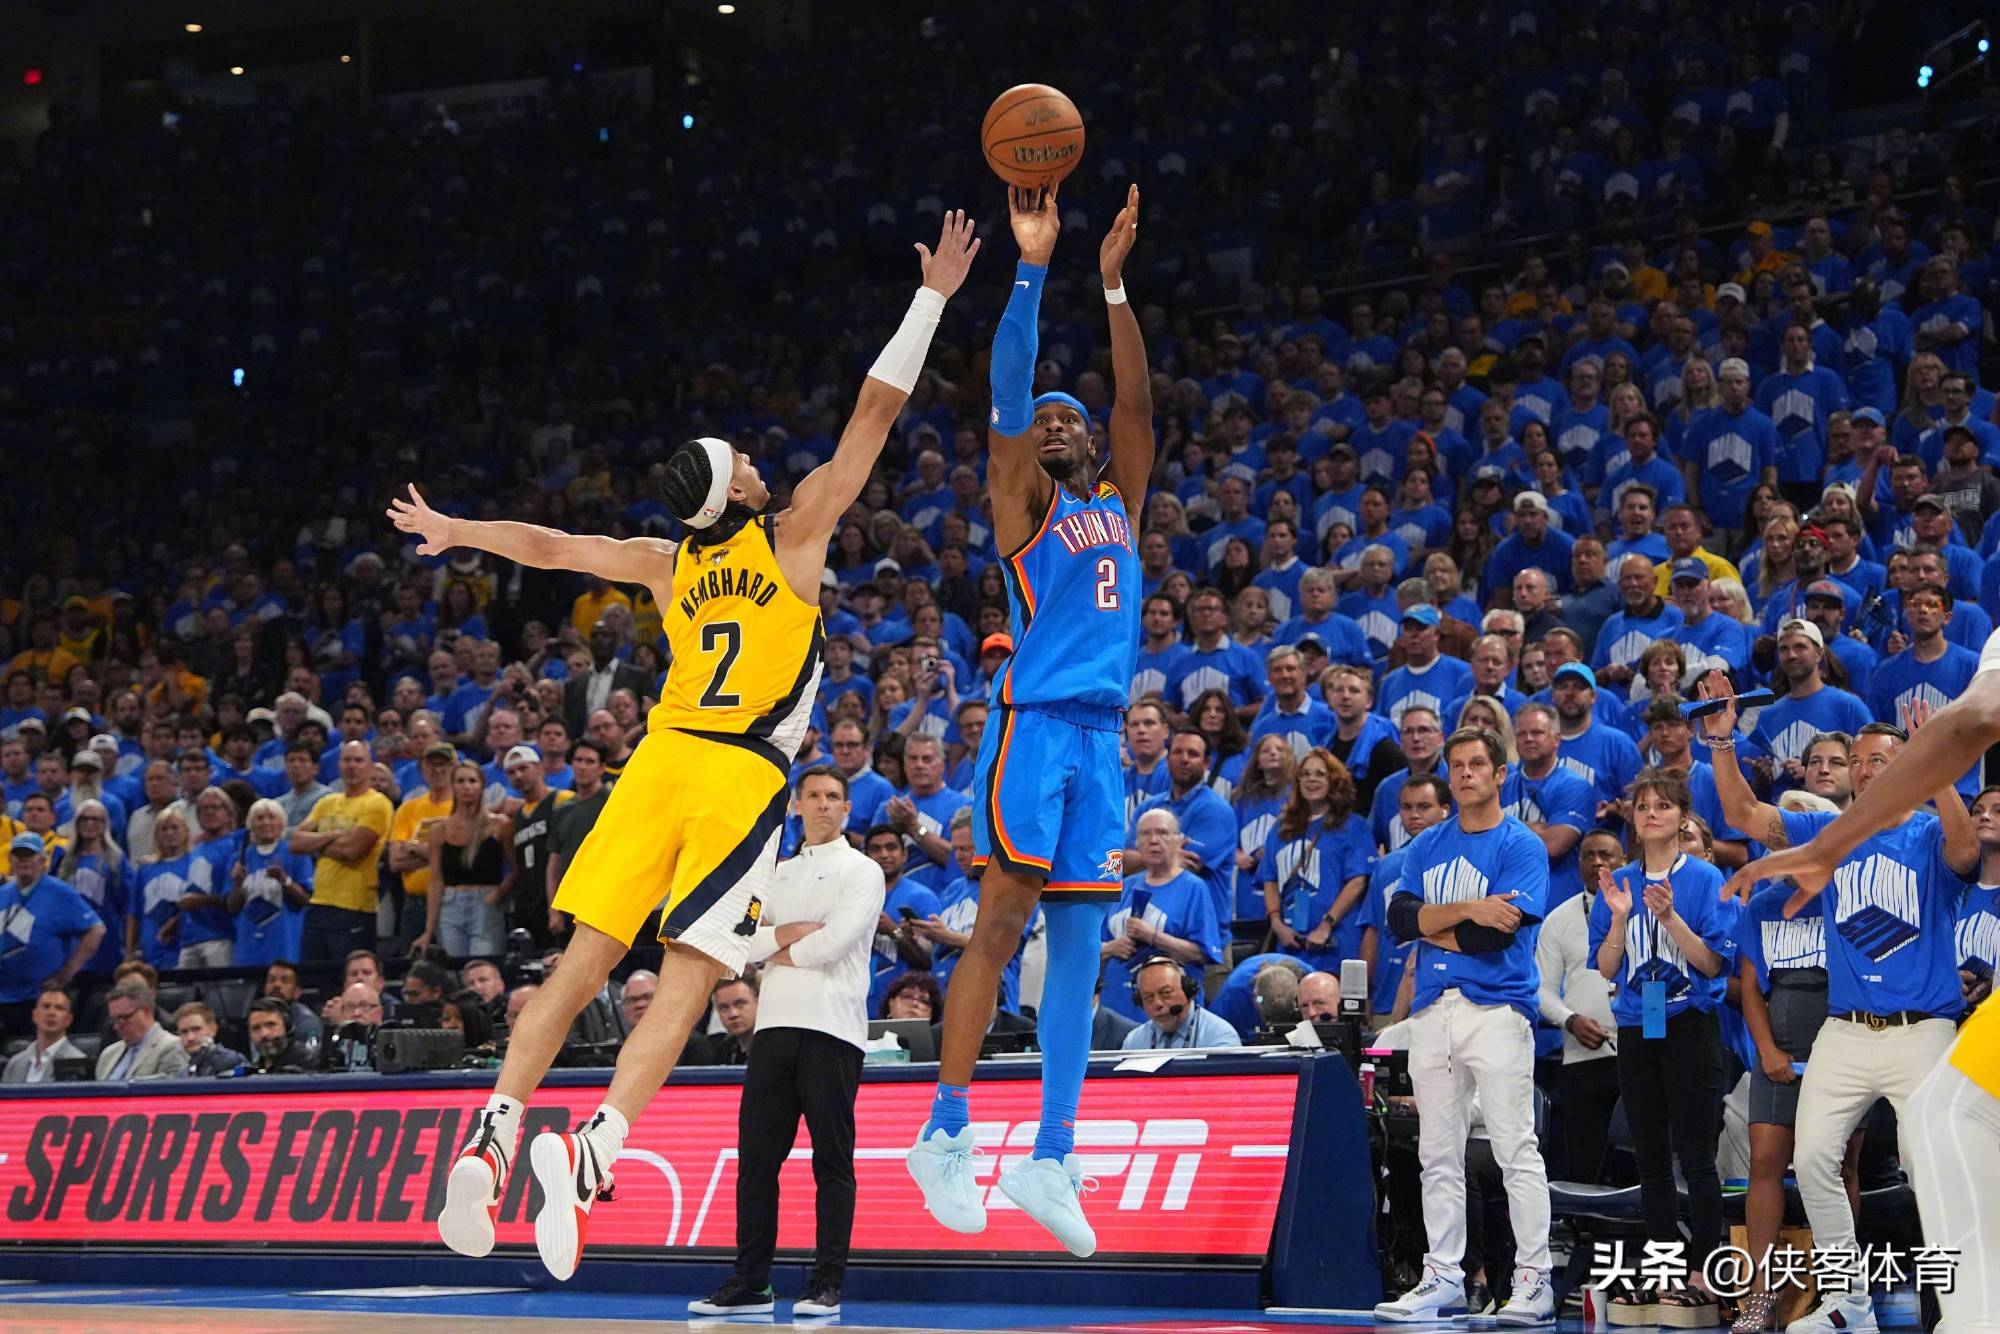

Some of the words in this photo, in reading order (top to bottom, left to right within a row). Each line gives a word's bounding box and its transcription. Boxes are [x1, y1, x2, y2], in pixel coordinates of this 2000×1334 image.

[680, 567, 778, 621] NEMBHARD
[1096, 557, 1120, 611] 2
[699, 621, 742, 709] 2
[7, 1112, 266, 1223] SPORTS
[254, 1106, 571, 1223] FOREVR
